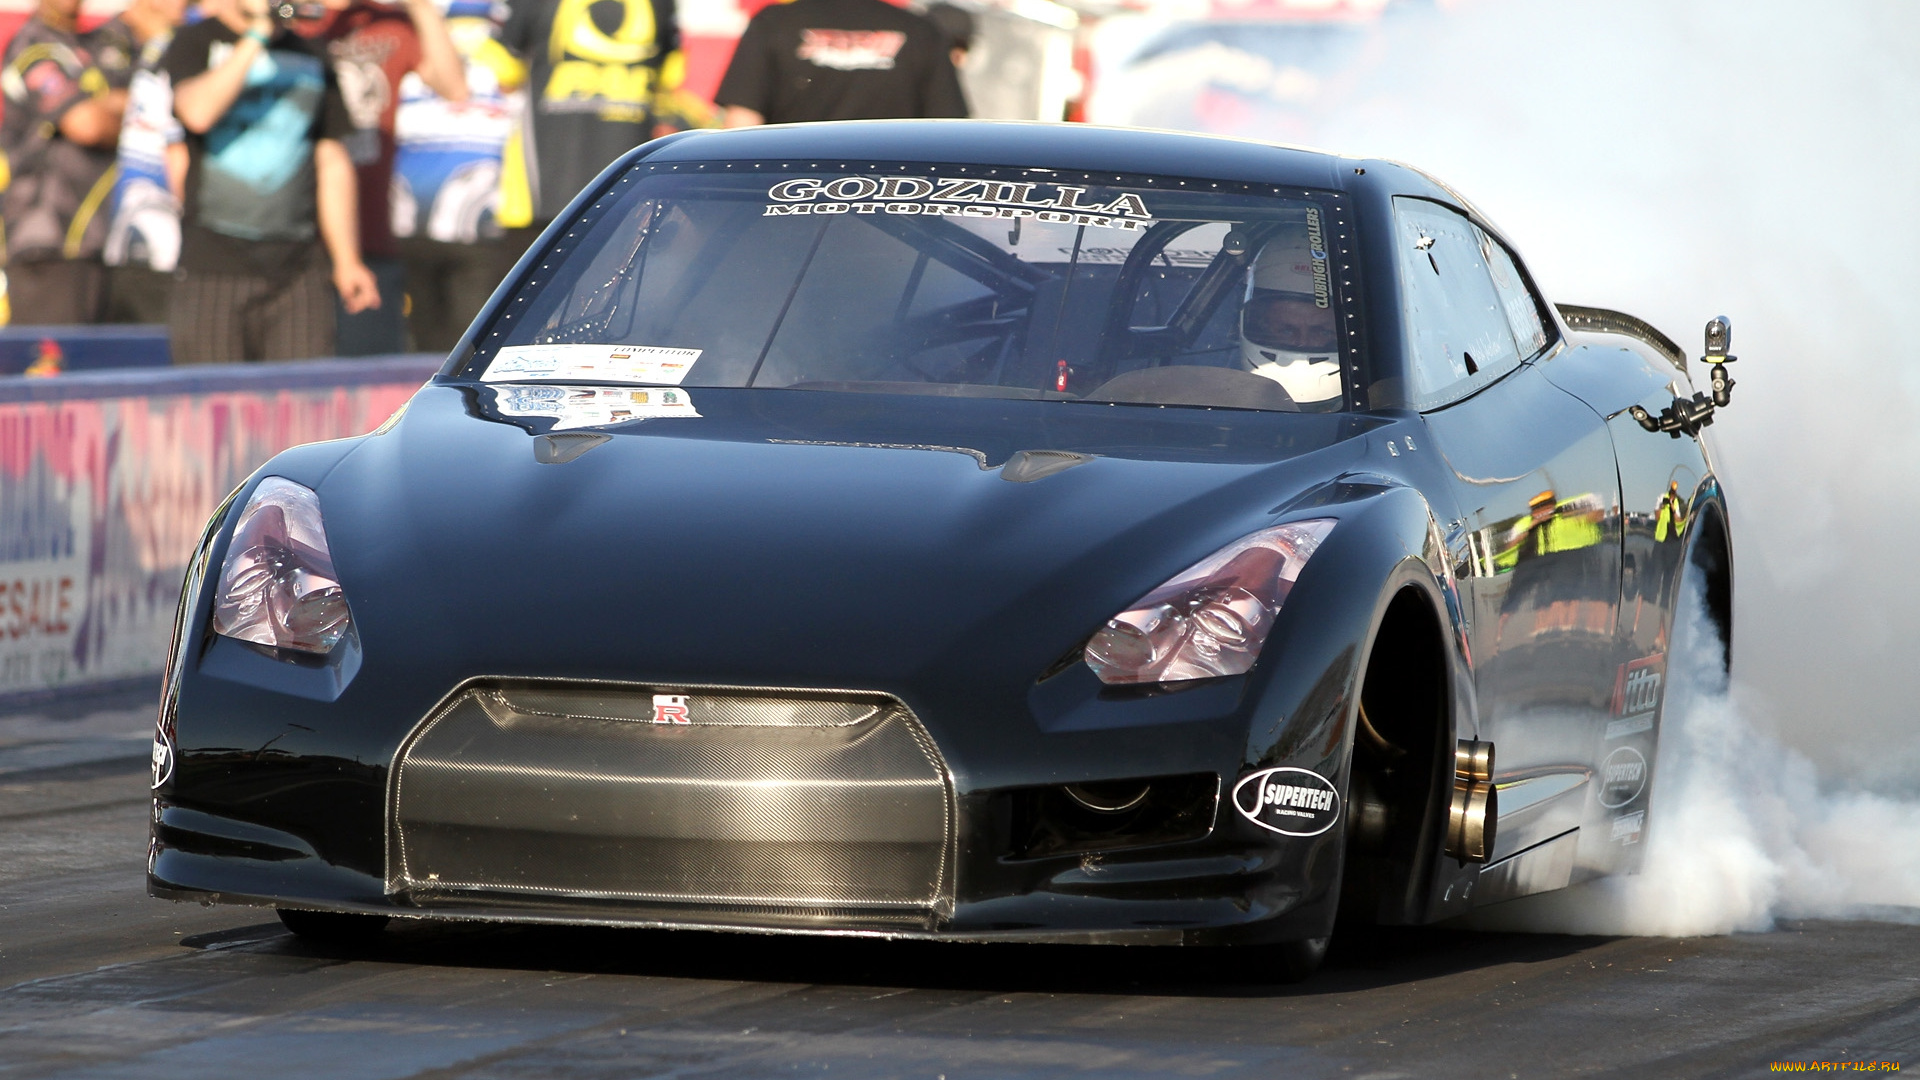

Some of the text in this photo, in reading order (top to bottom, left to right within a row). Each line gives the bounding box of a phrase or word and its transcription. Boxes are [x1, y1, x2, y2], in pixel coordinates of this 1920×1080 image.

[768, 177, 1153, 219] GODZILLA
[762, 202, 1149, 231] MOTORSPORT
[1606, 762, 1643, 783] SUPERTECH
[1264, 783, 1334, 811] SUPERTECH
[1296, 810, 1315, 819] VALVES
